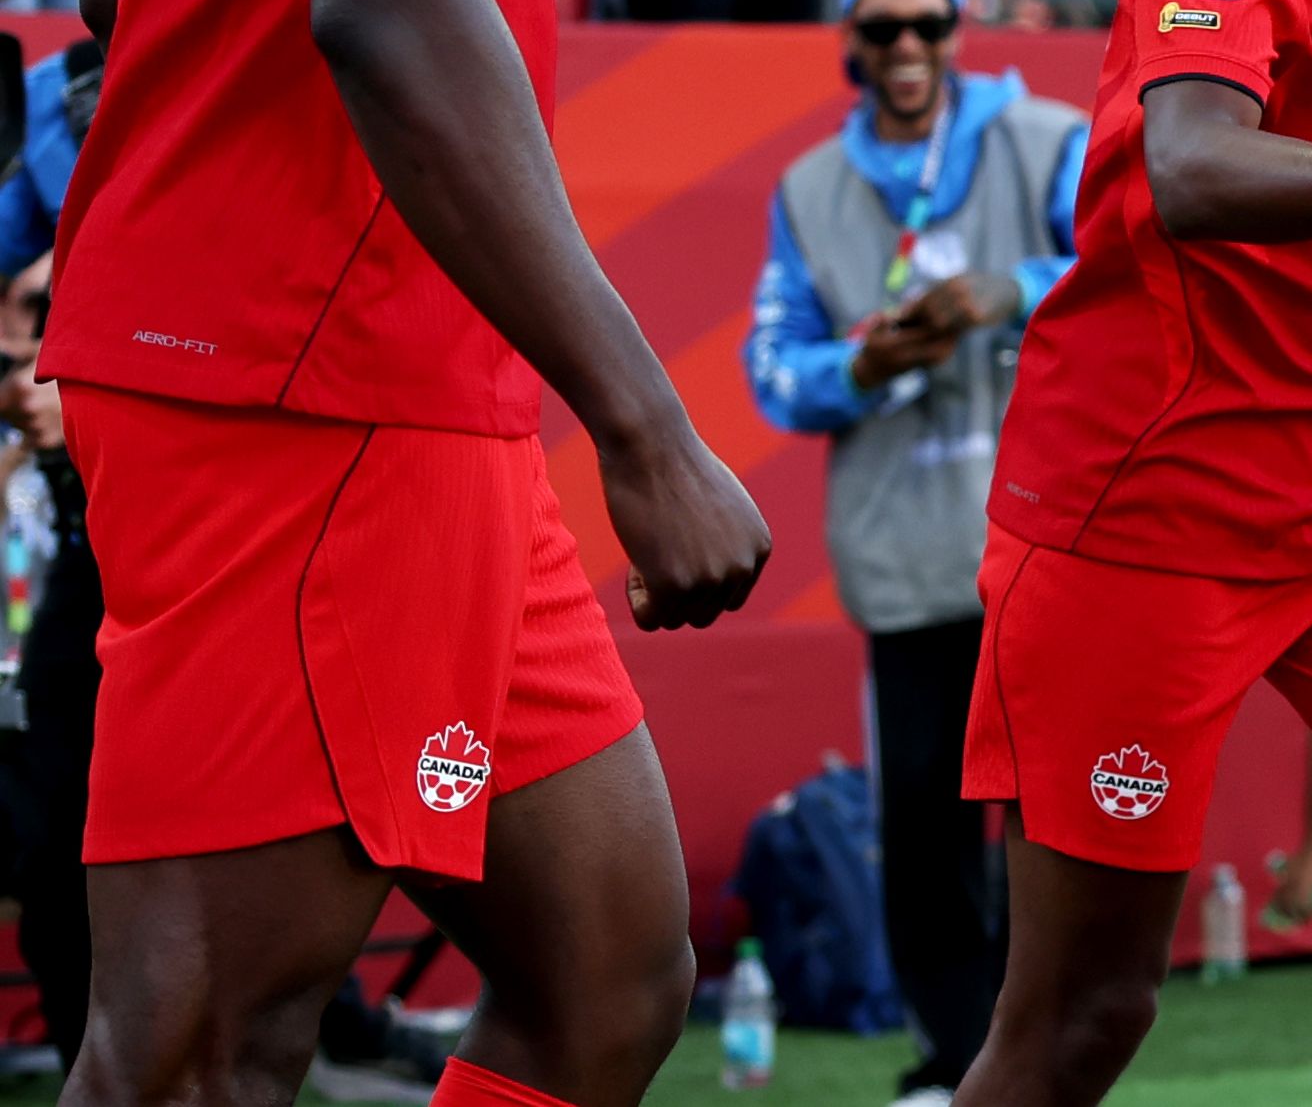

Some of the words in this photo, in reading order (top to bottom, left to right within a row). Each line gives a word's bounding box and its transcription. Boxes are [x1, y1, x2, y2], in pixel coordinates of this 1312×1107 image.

[1174, 13, 1216, 22] DEBUT
[132, 330, 219, 355] AERO-FIT
[419, 757, 484, 782] CANADA
[1093, 773, 1164, 794] CANADA
